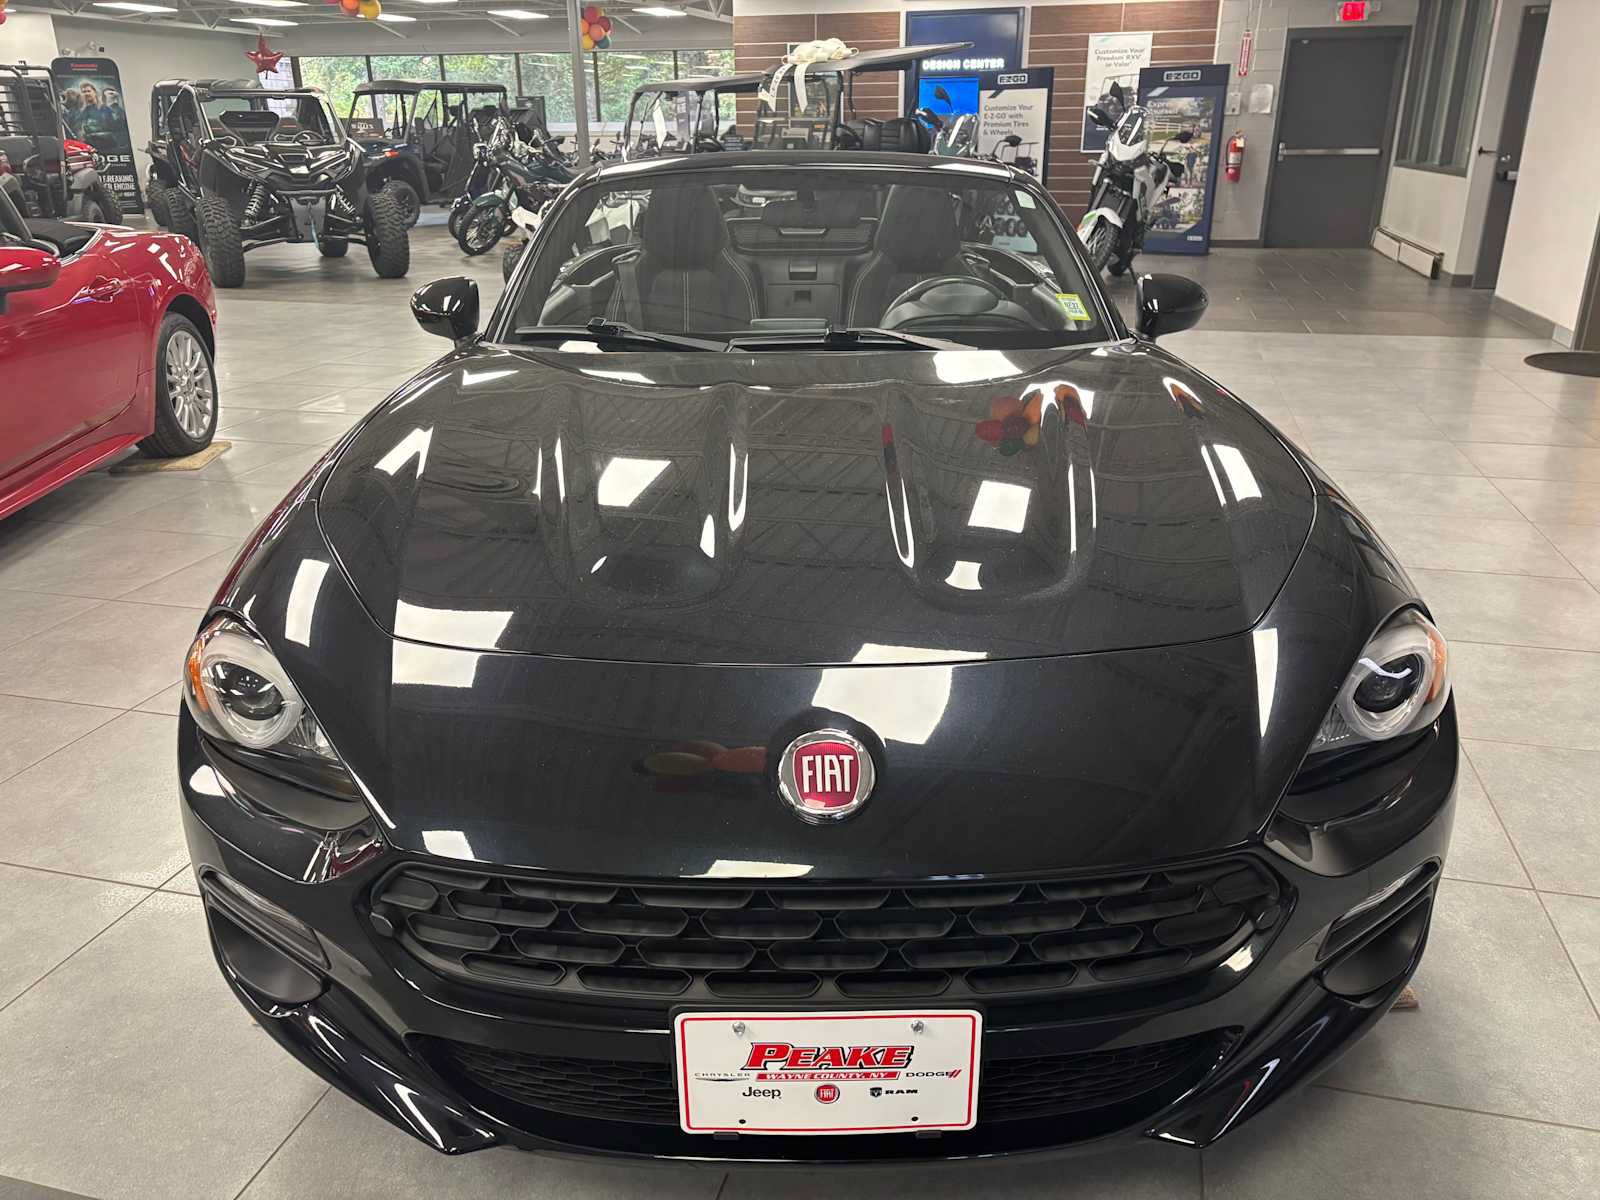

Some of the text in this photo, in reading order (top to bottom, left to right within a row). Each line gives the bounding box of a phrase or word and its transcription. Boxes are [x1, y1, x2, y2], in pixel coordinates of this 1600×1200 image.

[922, 58, 1005, 70] DESIGN CENTER
[802, 754, 854, 793] FIAT
[739, 1042, 915, 1071] PEAKE
[766, 1072, 812, 1080] WAYNE
[871, 1071, 889, 1079] NY
[742, 1086, 781, 1099] Jeep
[819, 1088, 835, 1099] FIAT
